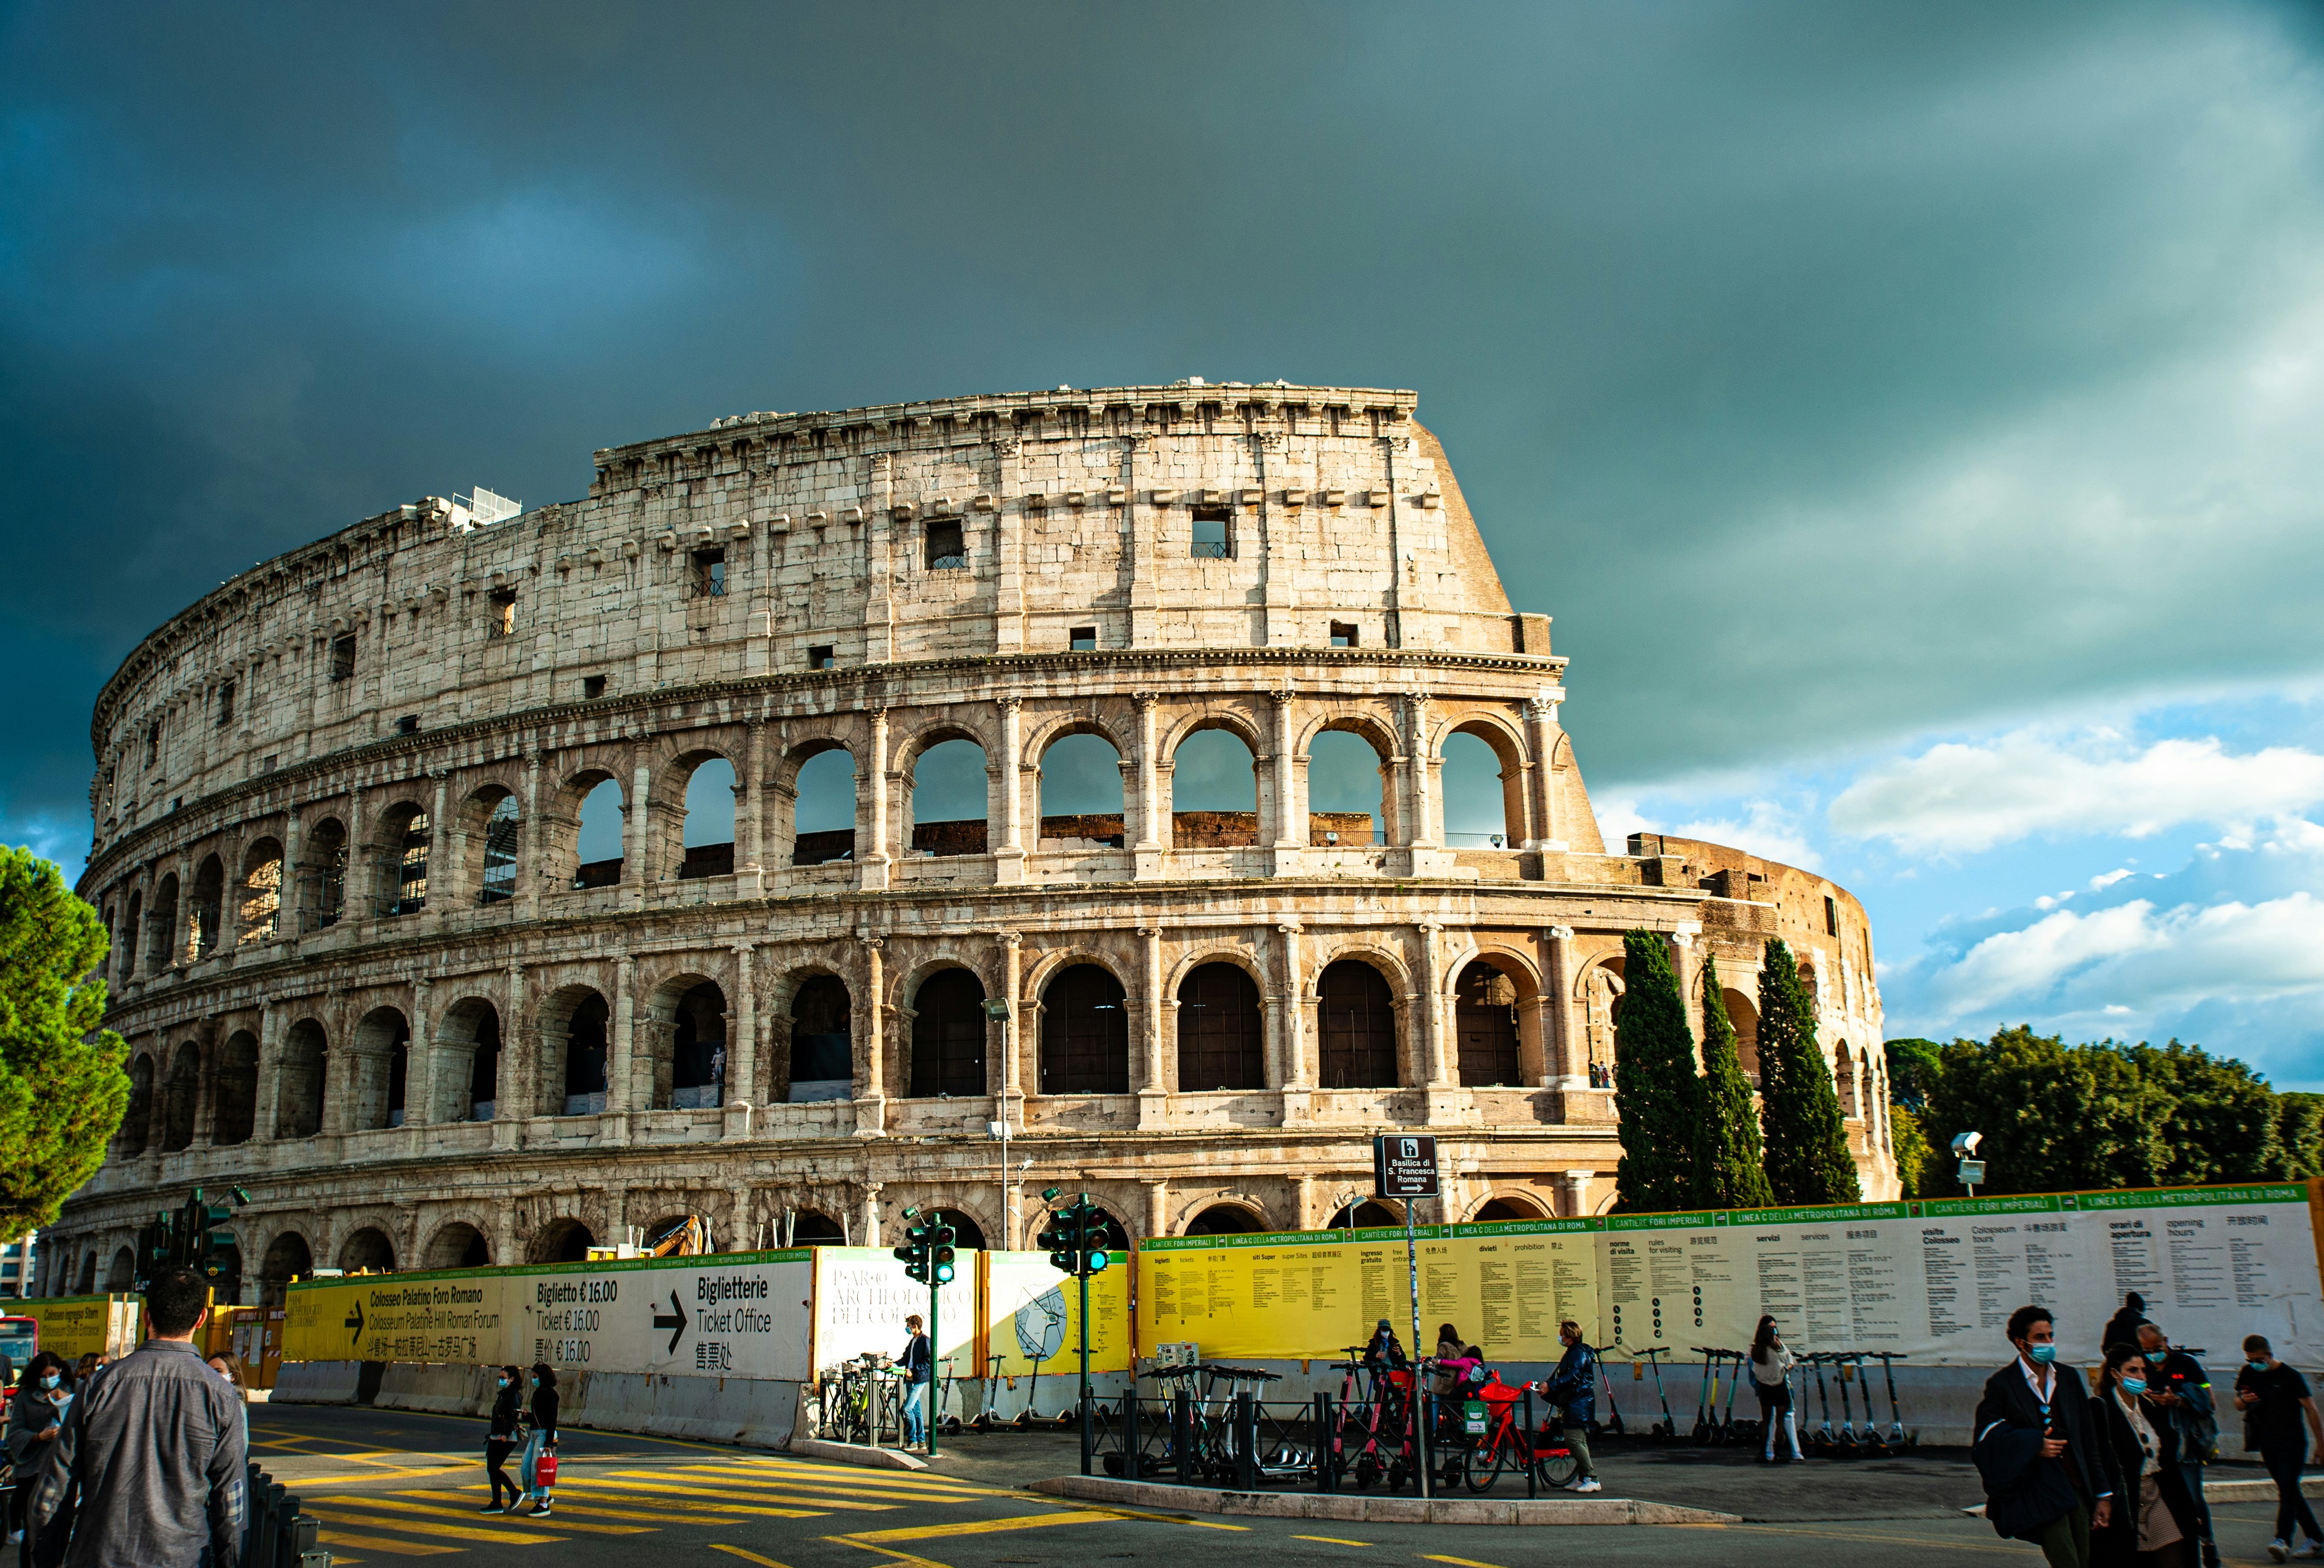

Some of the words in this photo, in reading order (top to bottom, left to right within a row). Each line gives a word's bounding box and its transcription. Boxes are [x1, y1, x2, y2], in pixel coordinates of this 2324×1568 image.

[2088, 1197, 2117, 1206] LINEA
[2120, 1196, 2127, 1204] C
[2130, 1194, 2160, 1204] DELLA
[2161, 1190, 2249, 1203] METROPOLITANA
[2250, 1190, 2263, 1199] DI
[2265, 1189, 2298, 1198] ROMA
[1935, 1203, 1977, 1213] CANTIERE
[1979, 1202, 1999, 1211] FORI
[1737, 1214, 1760, 1222] LINEA
[1769, 1212, 1793, 1221] DELLA
[1794, 1209, 1861, 1219] METROPOLITANA
[1863, 1208, 1871, 1217] DI
[1873, 1207, 1897, 1216] ROMA
[1616, 1219, 1647, 1227] CANTIERE
[1668, 1216, 1704, 1225] IMPERIALI
[2109, 1220, 2132, 1229] orari
[2133, 1219, 2143, 1228] di
[2166, 1218, 2205, 1228] opening
[1504, 1223, 1557, 1232] METROPOLITANA
[1971, 1226, 2016, 1235] Colosseum
[2167, 1228, 2195, 1237] hours
[1269, 1234, 1313, 1243] METROPOLITANA
[1361, 1231, 1388, 1239] CANTIERE
[1403, 1228, 1432, 1237] IMERIALI
[1756, 1233, 1780, 1242] servizi
[2110, 1230, 2151, 1240] apertura
[1922, 1236, 1960, 1245] Colosseo
[1514, 1243, 1545, 1252] prohibition
[1660, 1246, 1682, 1255] visiting
[538, 1282, 577, 1308] Biglietto
[579, 1281, 586, 1303] €
[589, 1280, 617, 1303] 16.00
[698, 1274, 768, 1305] Biglietterie
[370, 1290, 401, 1308] Colosseo
[403, 1288, 431, 1306] Palatino
[433, 1287, 449, 1305] Foro
[451, 1286, 482, 1304] Romano
[369, 1313, 404, 1330] Colosseum
[406, 1311, 433, 1329] Palatine
[434, 1311, 446, 1329] Hill
[448, 1311, 472, 1329] Roman
[474, 1310, 499, 1329] Forum
[537, 1310, 562, 1331] Ticket
[564, 1309, 572, 1331] €
[573, 1309, 600, 1332] 16.00
[697, 1309, 731, 1333] Ticket
[735, 1308, 771, 1333] Office
[535, 1338, 553, 1363] 票价
[556, 1339, 563, 1361] €
[565, 1340, 591, 1362] 16.00
[695, 1340, 732, 1371] 售票处
